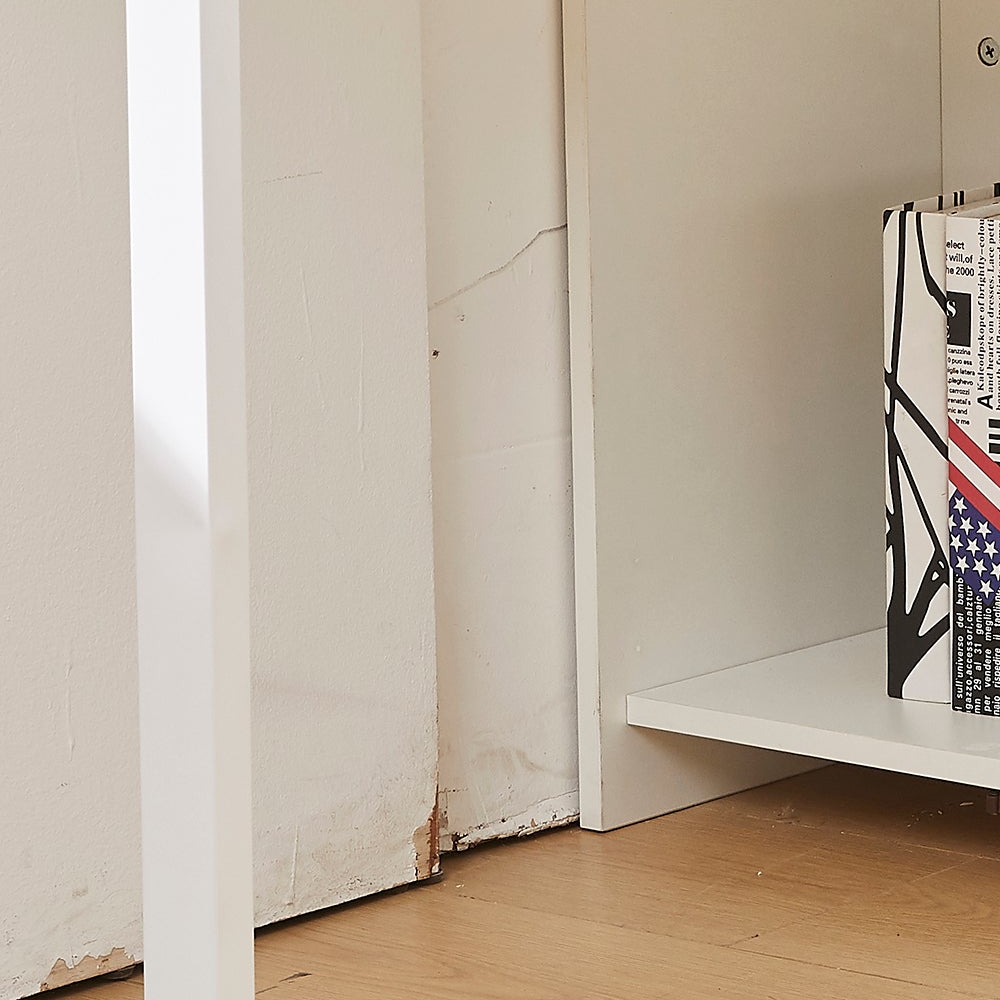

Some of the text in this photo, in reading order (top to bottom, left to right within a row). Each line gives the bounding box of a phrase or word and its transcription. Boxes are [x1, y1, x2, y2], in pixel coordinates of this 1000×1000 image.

[956, 267, 974, 276] 2000
[978, 302, 985, 312] of
[988, 321, 994, 333] on
[977, 394, 993, 410] A
[956, 574, 964, 605] bamb
[956, 613, 964, 628] del
[974, 643, 982, 654] 31
[983, 608, 993, 712] per vendere meglio
[974, 662, 982, 671] al
[974, 679, 981, 690] 29
